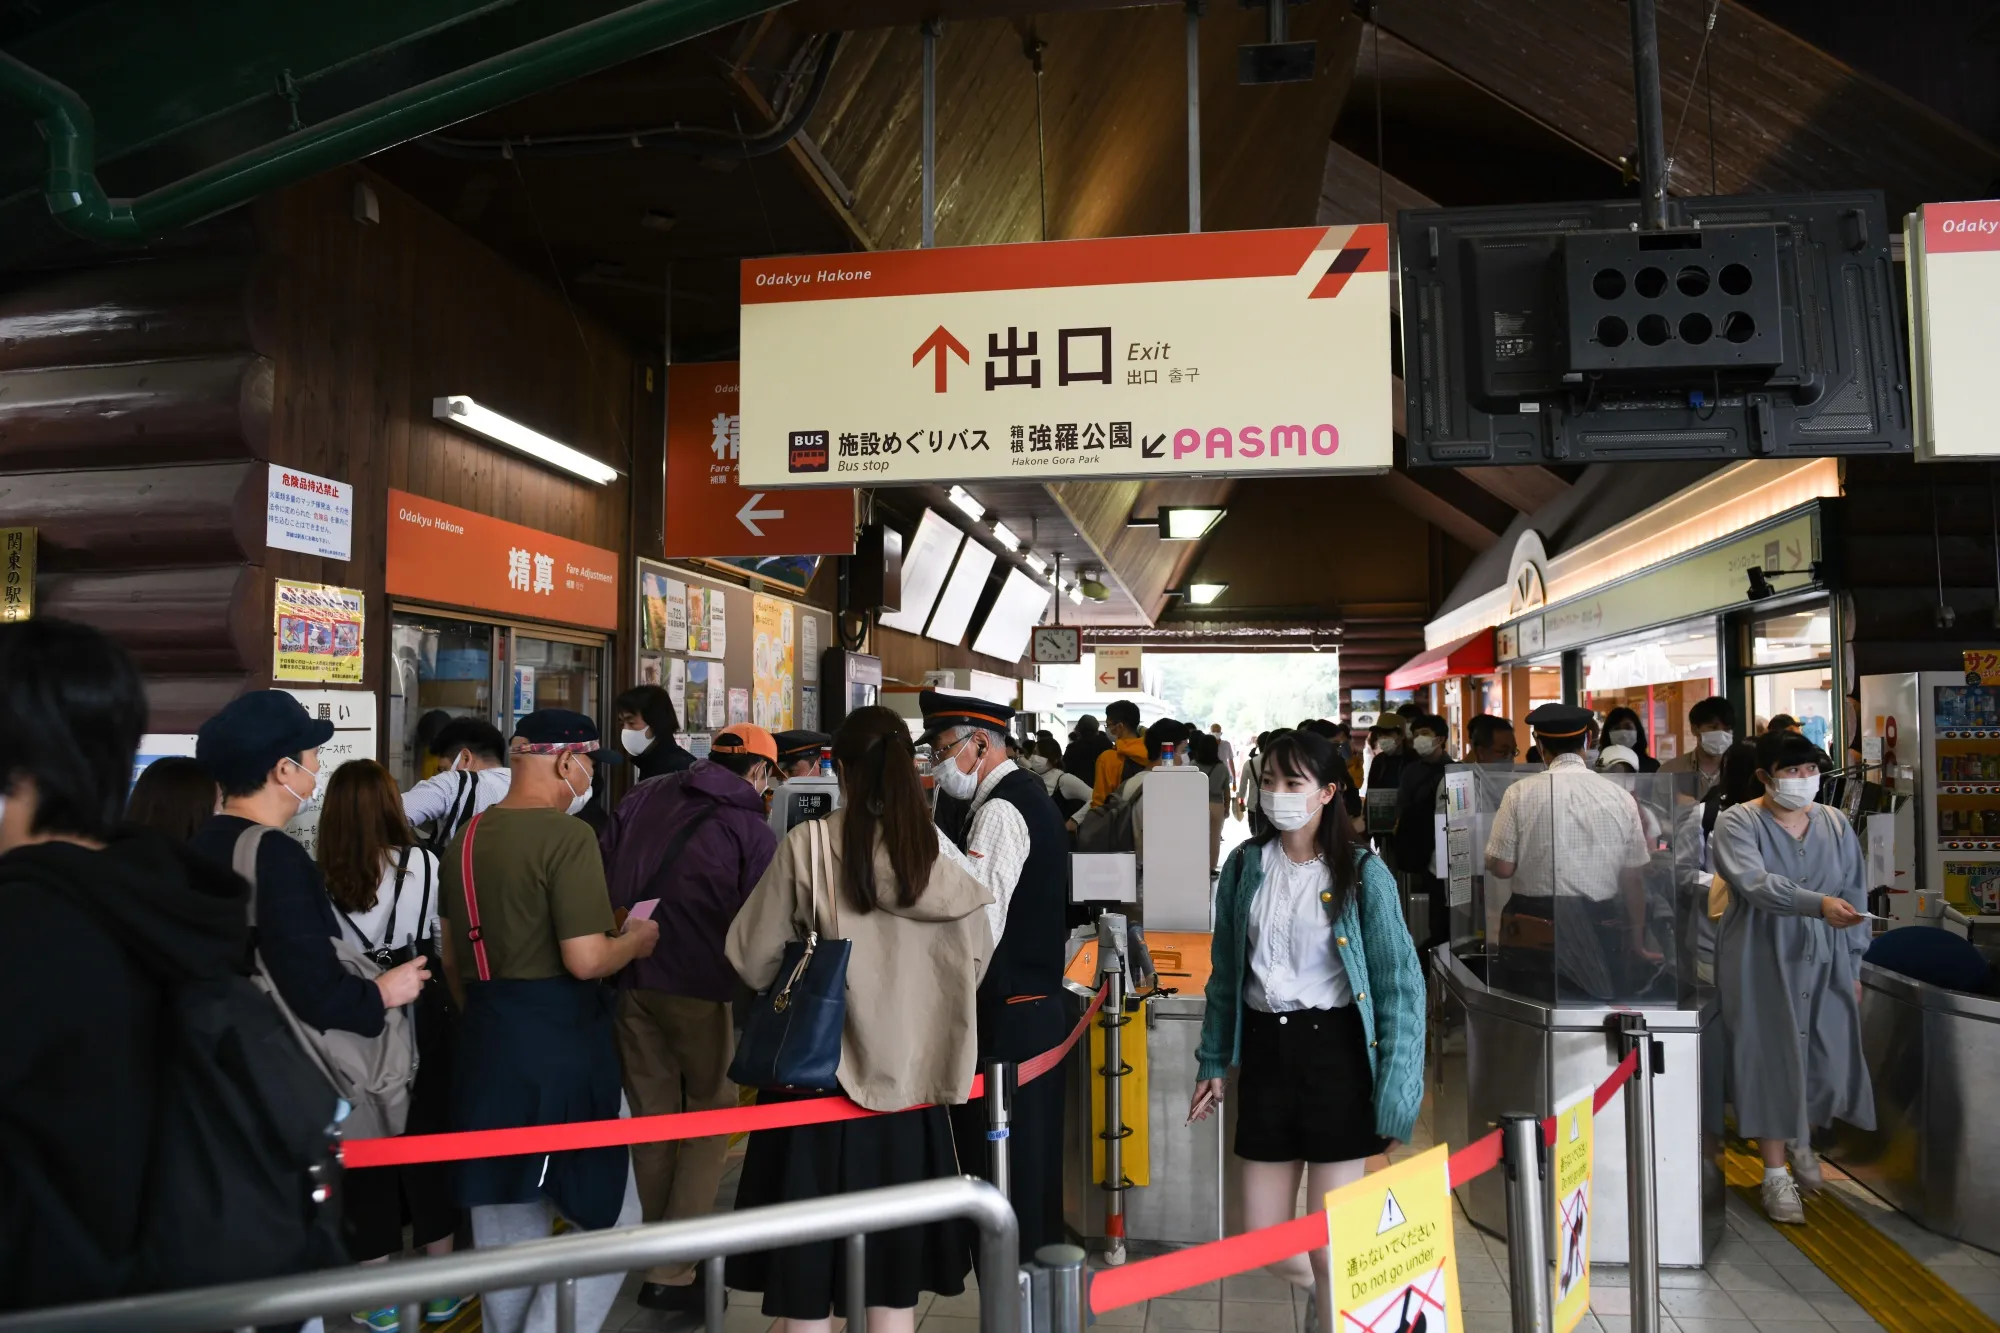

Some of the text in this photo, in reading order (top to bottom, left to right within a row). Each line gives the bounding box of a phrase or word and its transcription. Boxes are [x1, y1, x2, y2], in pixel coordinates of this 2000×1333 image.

[755, 268, 872, 287] Odakyu Hakone
[985, 326, 1112, 391] 出口
[1127, 341, 1171, 361] Exit
[1127, 367, 1200, 385] 出口 출구
[794, 435, 824, 447] BUS
[838, 428, 991, 458] 施設めぐりバス
[1010, 421, 1133, 453] 箱根 強羅公園
[1173, 423, 1340, 460] PASMO
[710, 464, 731, 473] Fare
[837, 459, 890, 473] Bus stop
[1011, 454, 1101, 467] Hakone Gora Park
[282, 473, 340, 499] 危険品持込禁止
[399, 508, 465, 535] Odakyu Hakone
[508, 546, 555, 596] 精算
[566, 563, 613, 584] Fare Adjustment
[1123, 670, 1132, 686] 1
[300, 702, 351, 721] 願い
[799, 795, 821, 807] 出場
[285, 825, 317, 837] ーカーを
[1347, 1222, 1436, 1278] 通らないでください
[1351, 1247, 1435, 1300] Do not go under
